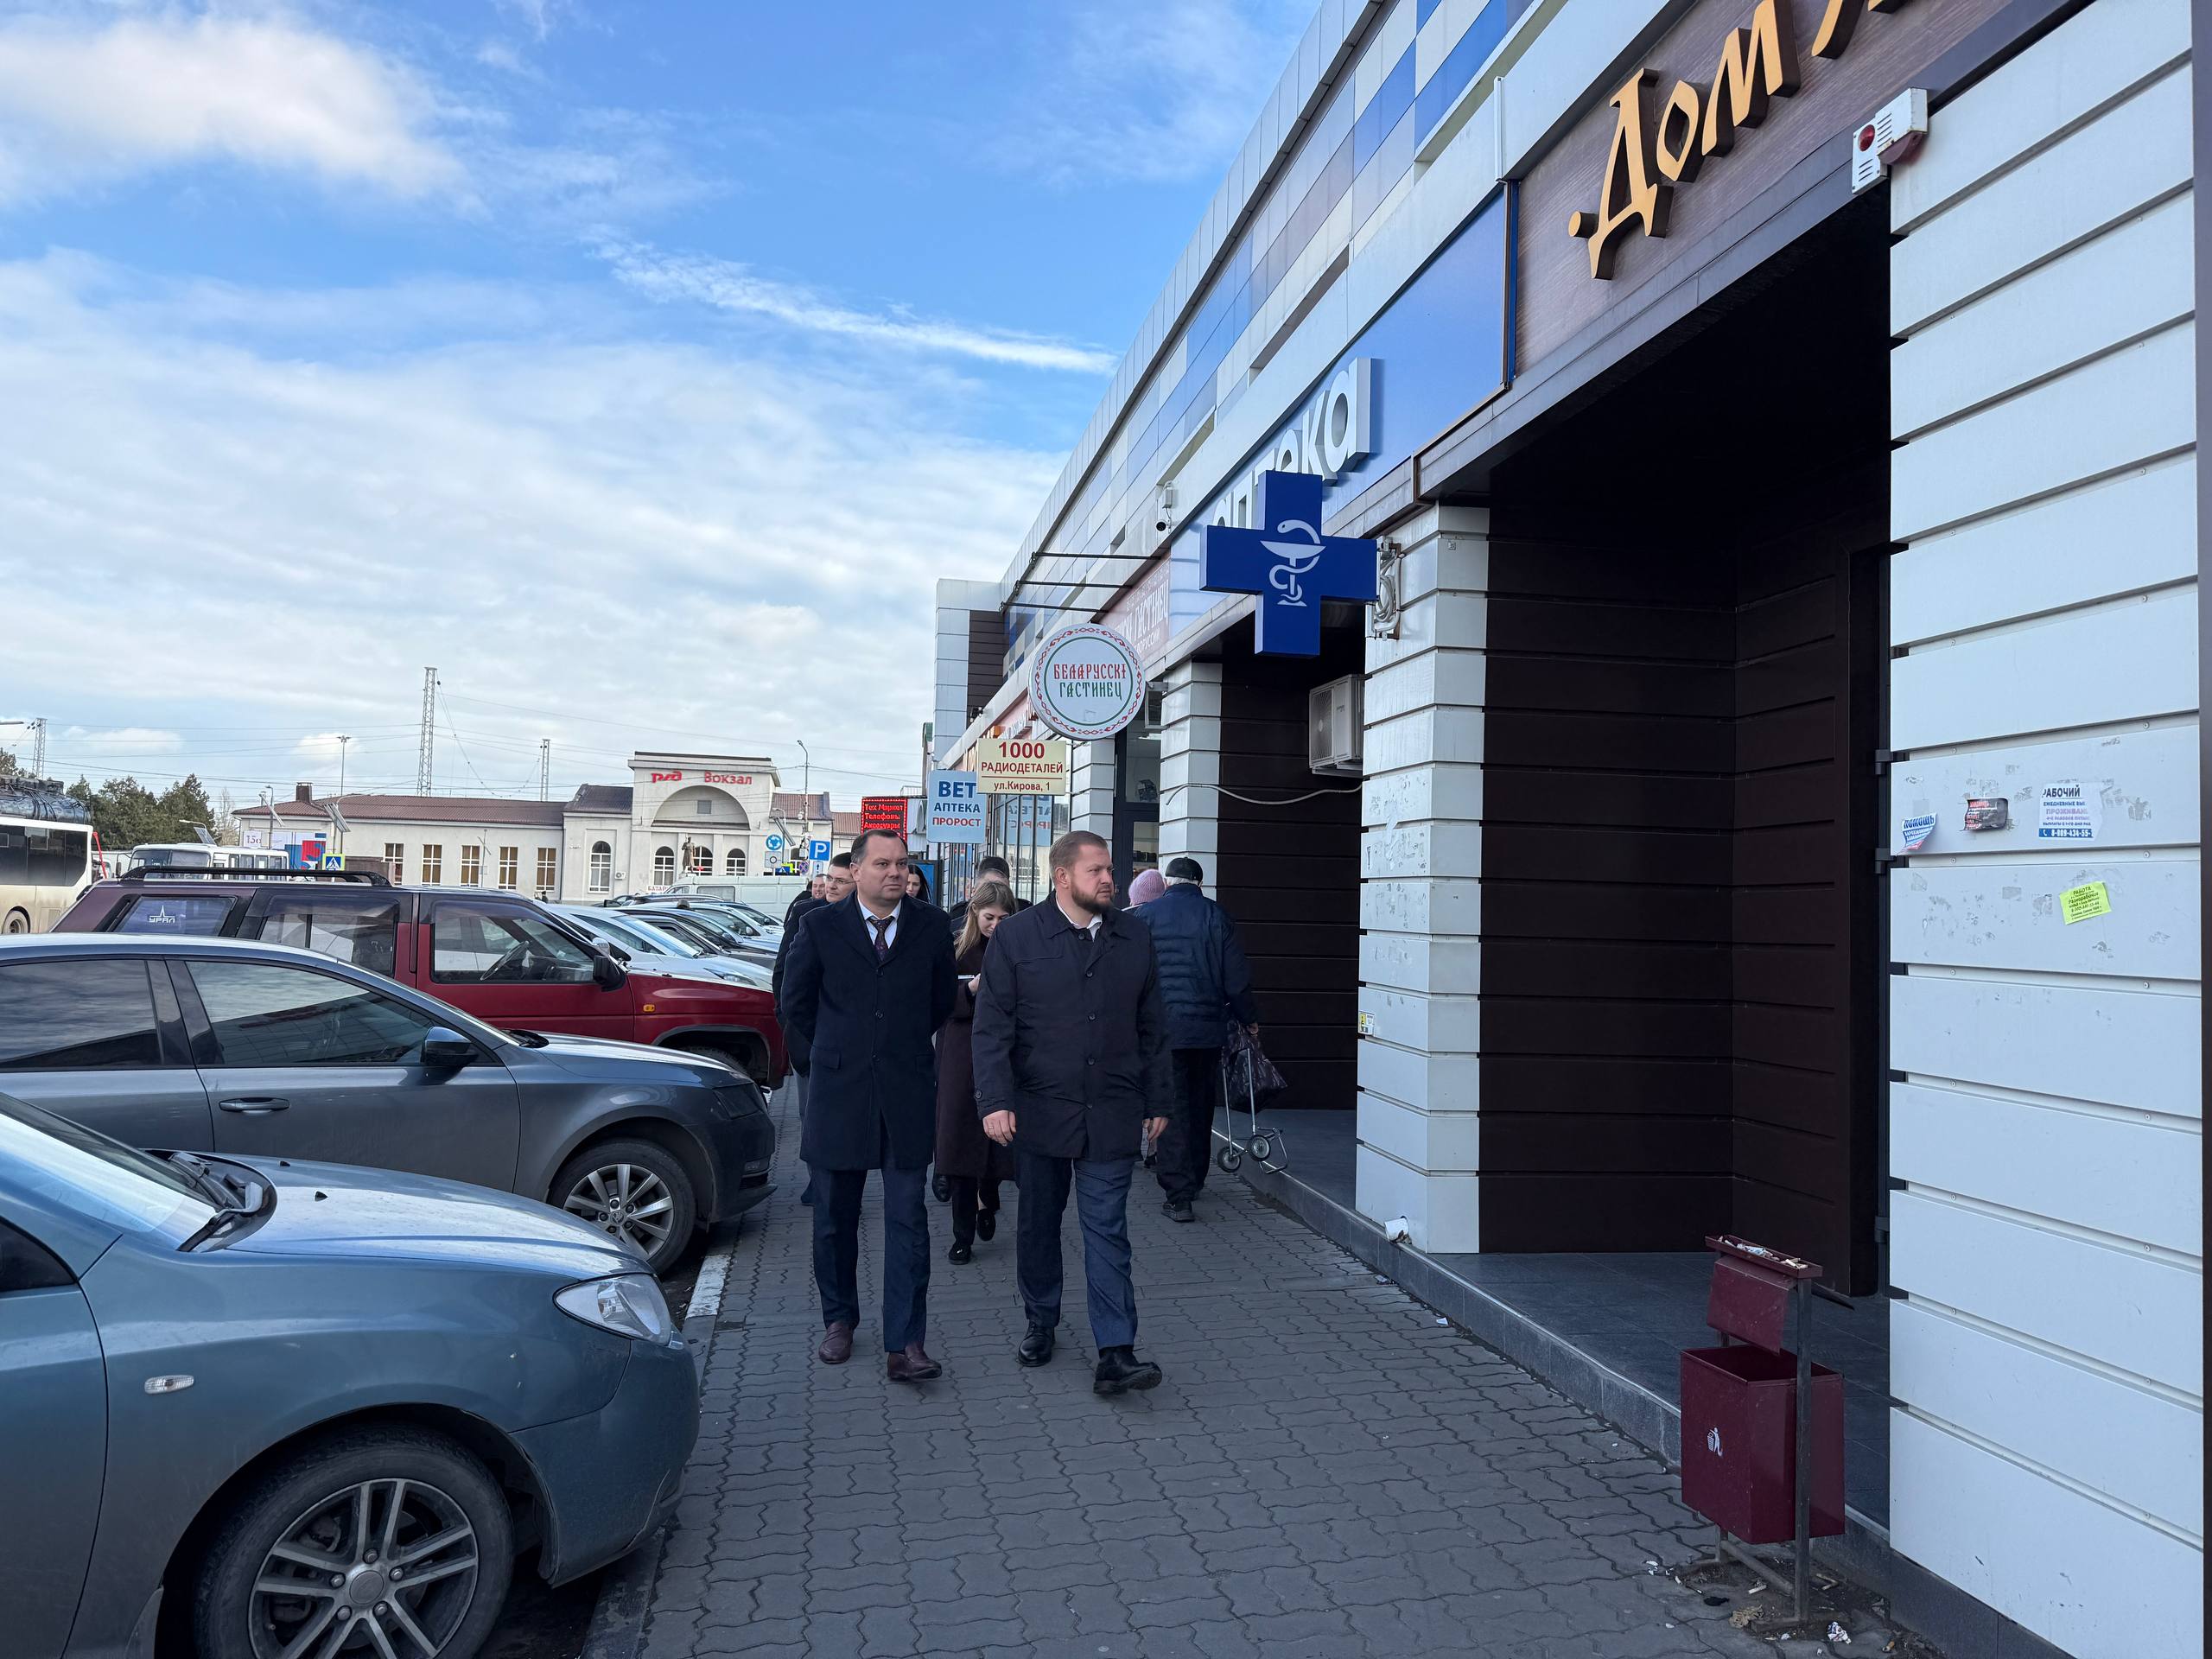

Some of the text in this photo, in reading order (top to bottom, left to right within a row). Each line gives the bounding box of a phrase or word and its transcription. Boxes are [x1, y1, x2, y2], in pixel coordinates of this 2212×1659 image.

[1569, 0, 1801, 280] Дом
[1059, 682, 1122, 701] ГАСТИНЕЦ
[999, 741, 1045, 759] 1000
[982, 761, 1063, 774] РАДИОДЕТАЛЕЙ
[704, 771, 752, 785] Вокзал
[938, 781, 976, 798] ВЕТ
[1046, 782, 1050, 791] 1
[878, 804, 903, 812] Маркет
[934, 803, 981, 813] АПТЕКА
[864, 812, 900, 821] Телефоны
[932, 817, 982, 827] ПРОРОСТ
[1904, 815, 1935, 830] ПОМОЩЬ
[814, 842, 827, 858] P
[2073, 887, 2092, 895] РАБОТА
